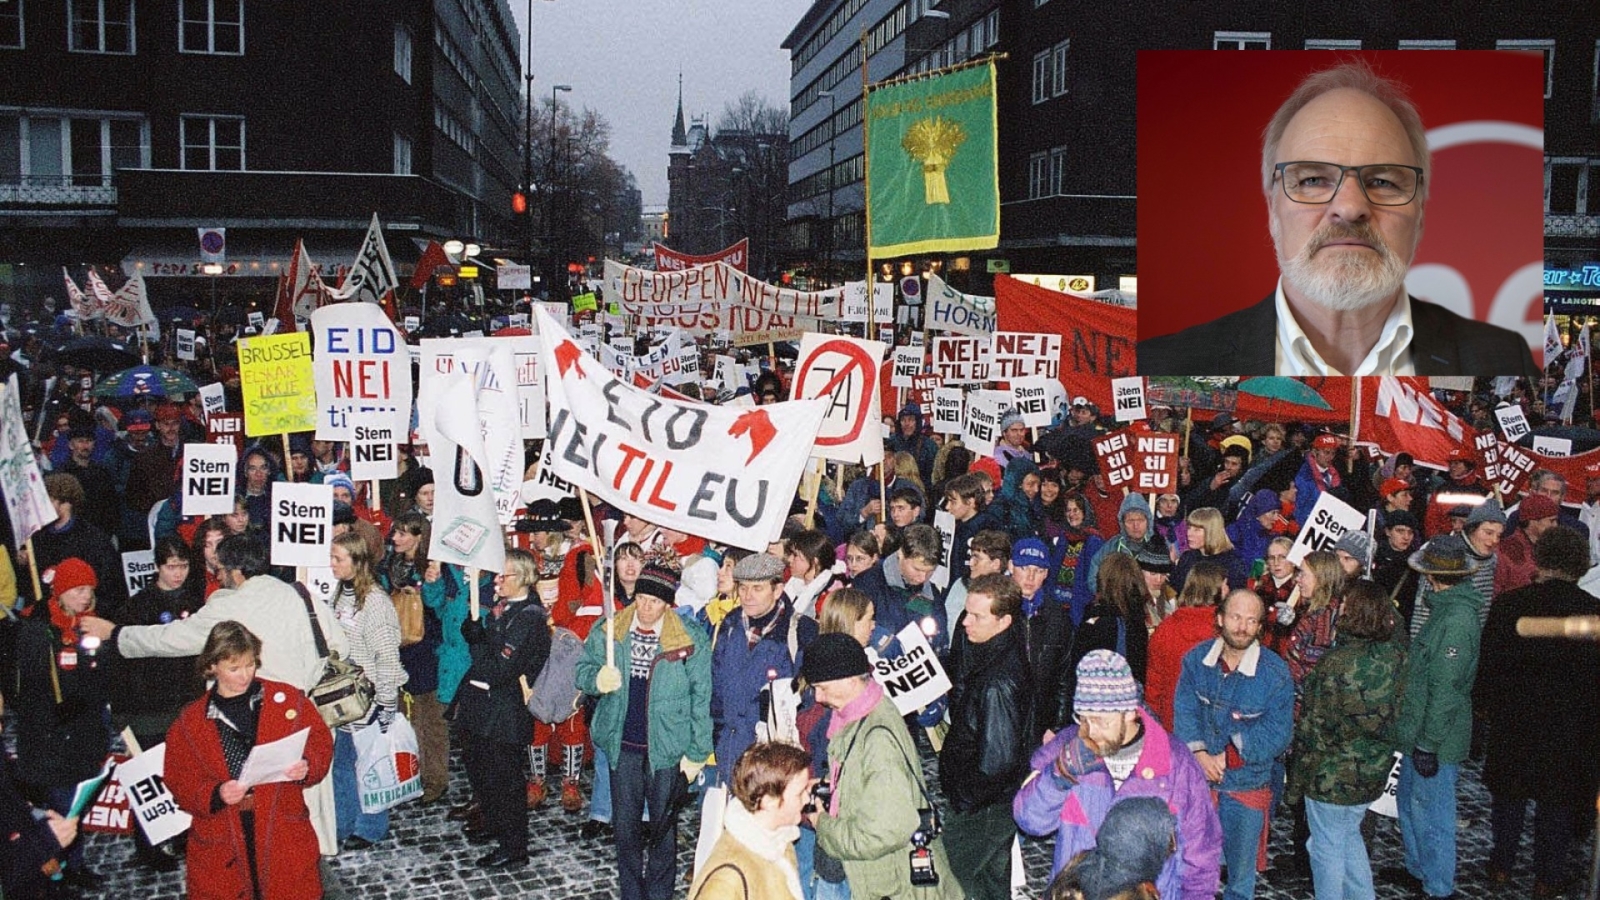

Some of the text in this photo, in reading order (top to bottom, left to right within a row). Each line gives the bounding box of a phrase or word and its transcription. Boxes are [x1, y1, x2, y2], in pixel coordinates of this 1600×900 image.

[623, 261, 730, 302] GLOPPEN
[741, 276, 781, 312] NEI
[178, 343, 193, 352] NEI
[327, 328, 396, 355] EID
[662, 357, 680, 375] EU
[681, 361, 698, 374] NEI
[896, 354, 920, 365] Stem
[995, 358, 1029, 378] TIL
[895, 365, 921, 376] NEI
[938, 363, 990, 379] TIL EU
[333, 360, 391, 399] NEI
[914, 377, 942, 390] NEI
[204, 394, 222, 407] Stem
[1015, 386, 1045, 399] Stem
[1115, 386, 1141, 398] Stem
[936, 396, 959, 407] Stem
[1015, 399, 1047, 415] NEI
[1117, 397, 1142, 411] NEI
[1375, 374, 1464, 444] NEI
[327, 405, 353, 428] ti
[935, 409, 959, 422] NEI
[971, 407, 995, 426] Stem
[1500, 415, 1523, 426] Stem
[209, 418, 241, 433] NEI
[354, 426, 392, 441] Stem
[968, 421, 994, 443] NEI
[1504, 422, 1528, 437] NEI
[355, 443, 393, 462] NEI
[1096, 433, 1128, 456] NEI
[1137, 437, 1176, 454] NEI
[189, 458, 230, 474] Stem
[1107, 452, 1127, 467] til
[1143, 455, 1166, 471] til
[1503, 446, 1536, 473] NEI
[1108, 465, 1135, 487] EU
[1500, 463, 1521, 481] til
[188, 477, 229, 496] NEI
[613, 443, 677, 512] TIL
[687, 471, 770, 528] EU
[1139, 473, 1170, 489] EU
[278, 499, 326, 519] Stem
[277, 522, 326, 545] NEI
[1302, 526, 1336, 552] NE
[875, 644, 925, 676] Stem
[883, 658, 937, 698] NEI
[142, 799, 176, 823] tem
